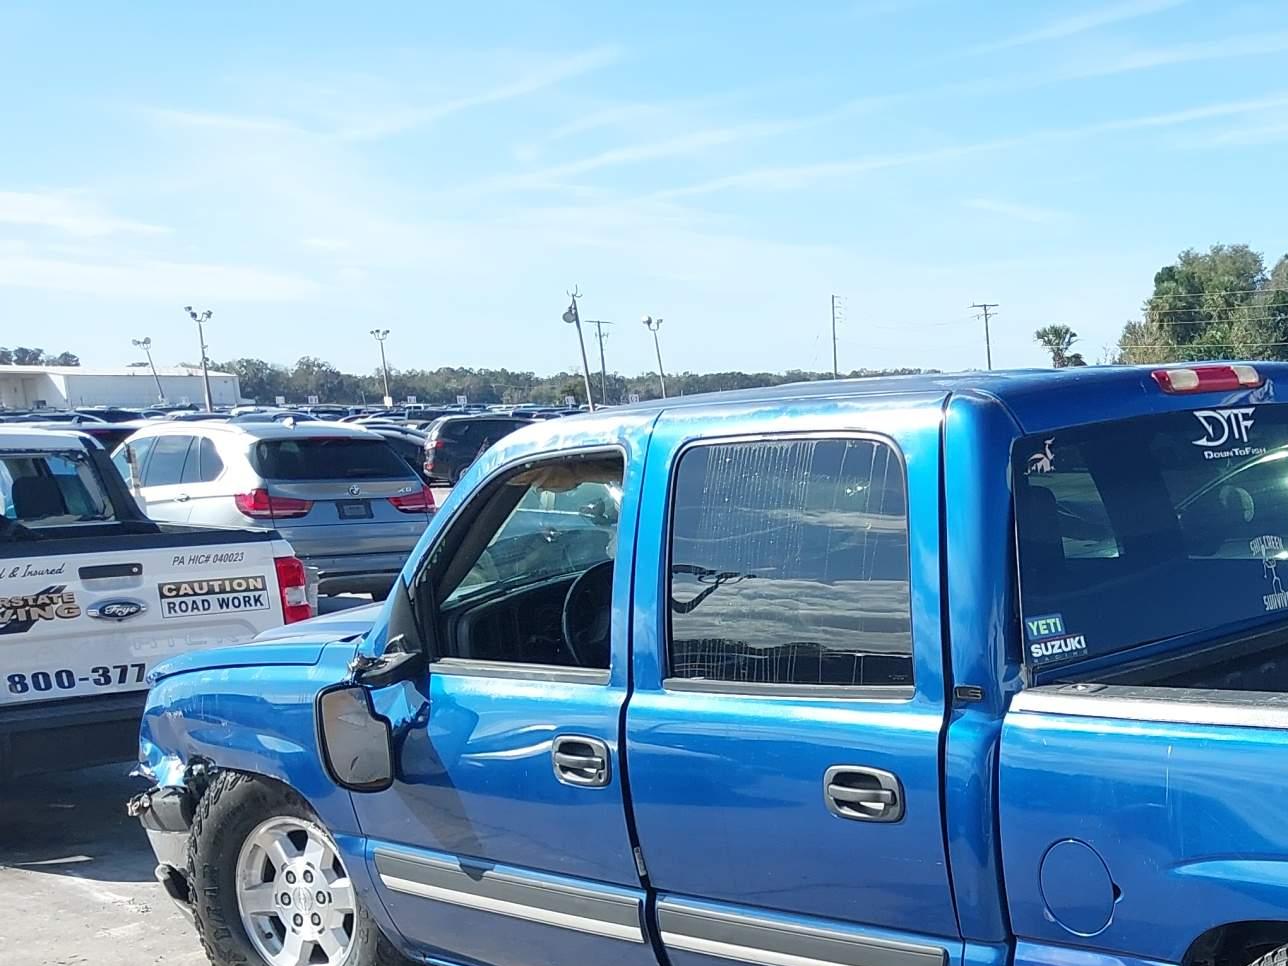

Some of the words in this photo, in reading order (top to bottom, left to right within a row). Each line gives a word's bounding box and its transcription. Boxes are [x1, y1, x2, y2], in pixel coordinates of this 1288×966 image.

[1192, 407, 1256, 446] DTF
[172, 556, 184, 565] PA
[188, 553, 210, 564] HIC#
[212, 552, 244, 563] 040023
[8, 566, 20, 578] &
[21, 562, 65, 577] Insured
[163, 578, 263, 596] CAUTION
[167, 599, 211, 614] ROAD
[217, 594, 264, 610] WORK
[1028, 618, 1062, 636] YETI
[1031, 635, 1086, 657] SUZUKI
[7, 663, 146, 694] 800-377
